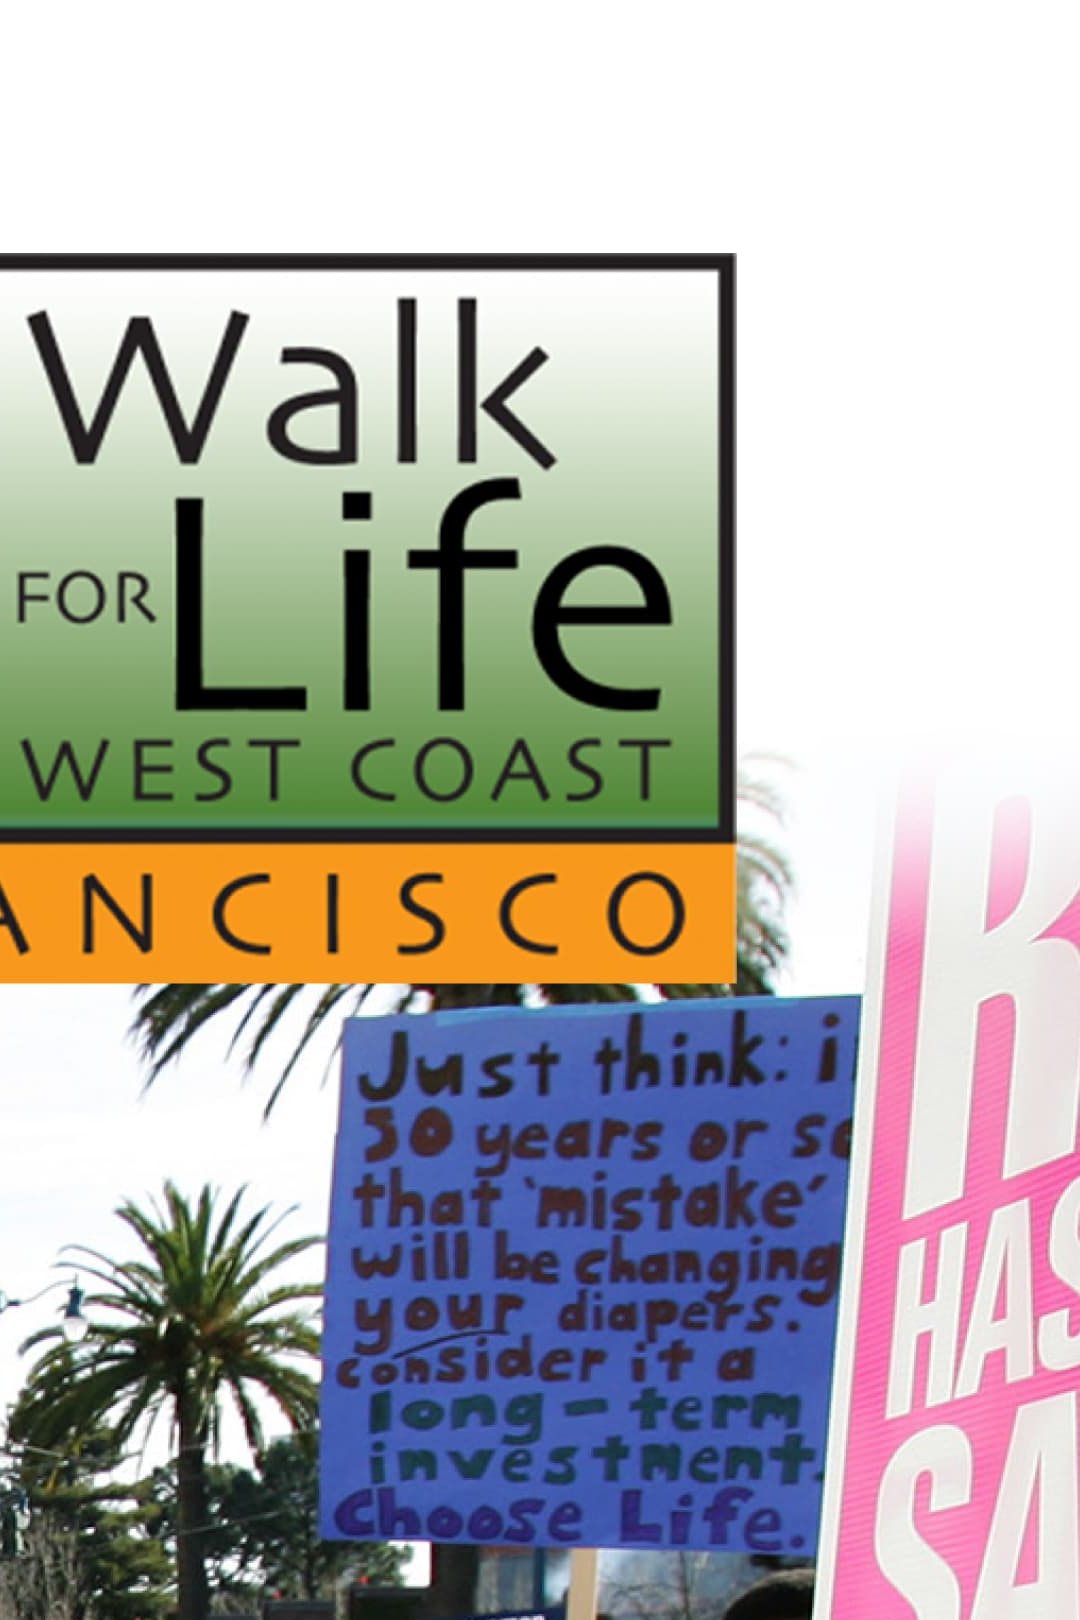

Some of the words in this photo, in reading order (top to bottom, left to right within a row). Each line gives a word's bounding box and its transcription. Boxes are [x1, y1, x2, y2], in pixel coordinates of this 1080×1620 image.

[357, 1031, 561, 1102] Just
[594, 1008, 788, 1096] think:
[475, 1116, 663, 1177] years
[689, 1118, 769, 1162] or
[352, 1166, 501, 1228] that
[351, 1231, 470, 1282] will
[494, 1231, 561, 1285] be
[574, 1236, 841, 1306] changing
[886, 1180, 1080, 1420] HAS
[353, 1293, 526, 1357] your
[557, 1289, 801, 1343] diapers.
[336, 1335, 609, 1389] consider
[631, 1339, 694, 1382] it
[717, 1346, 756, 1382] a
[368, 1434, 824, 1486] investment.
[333, 1486, 583, 1544] Choose
[622, 1486, 807, 1551] Life.
